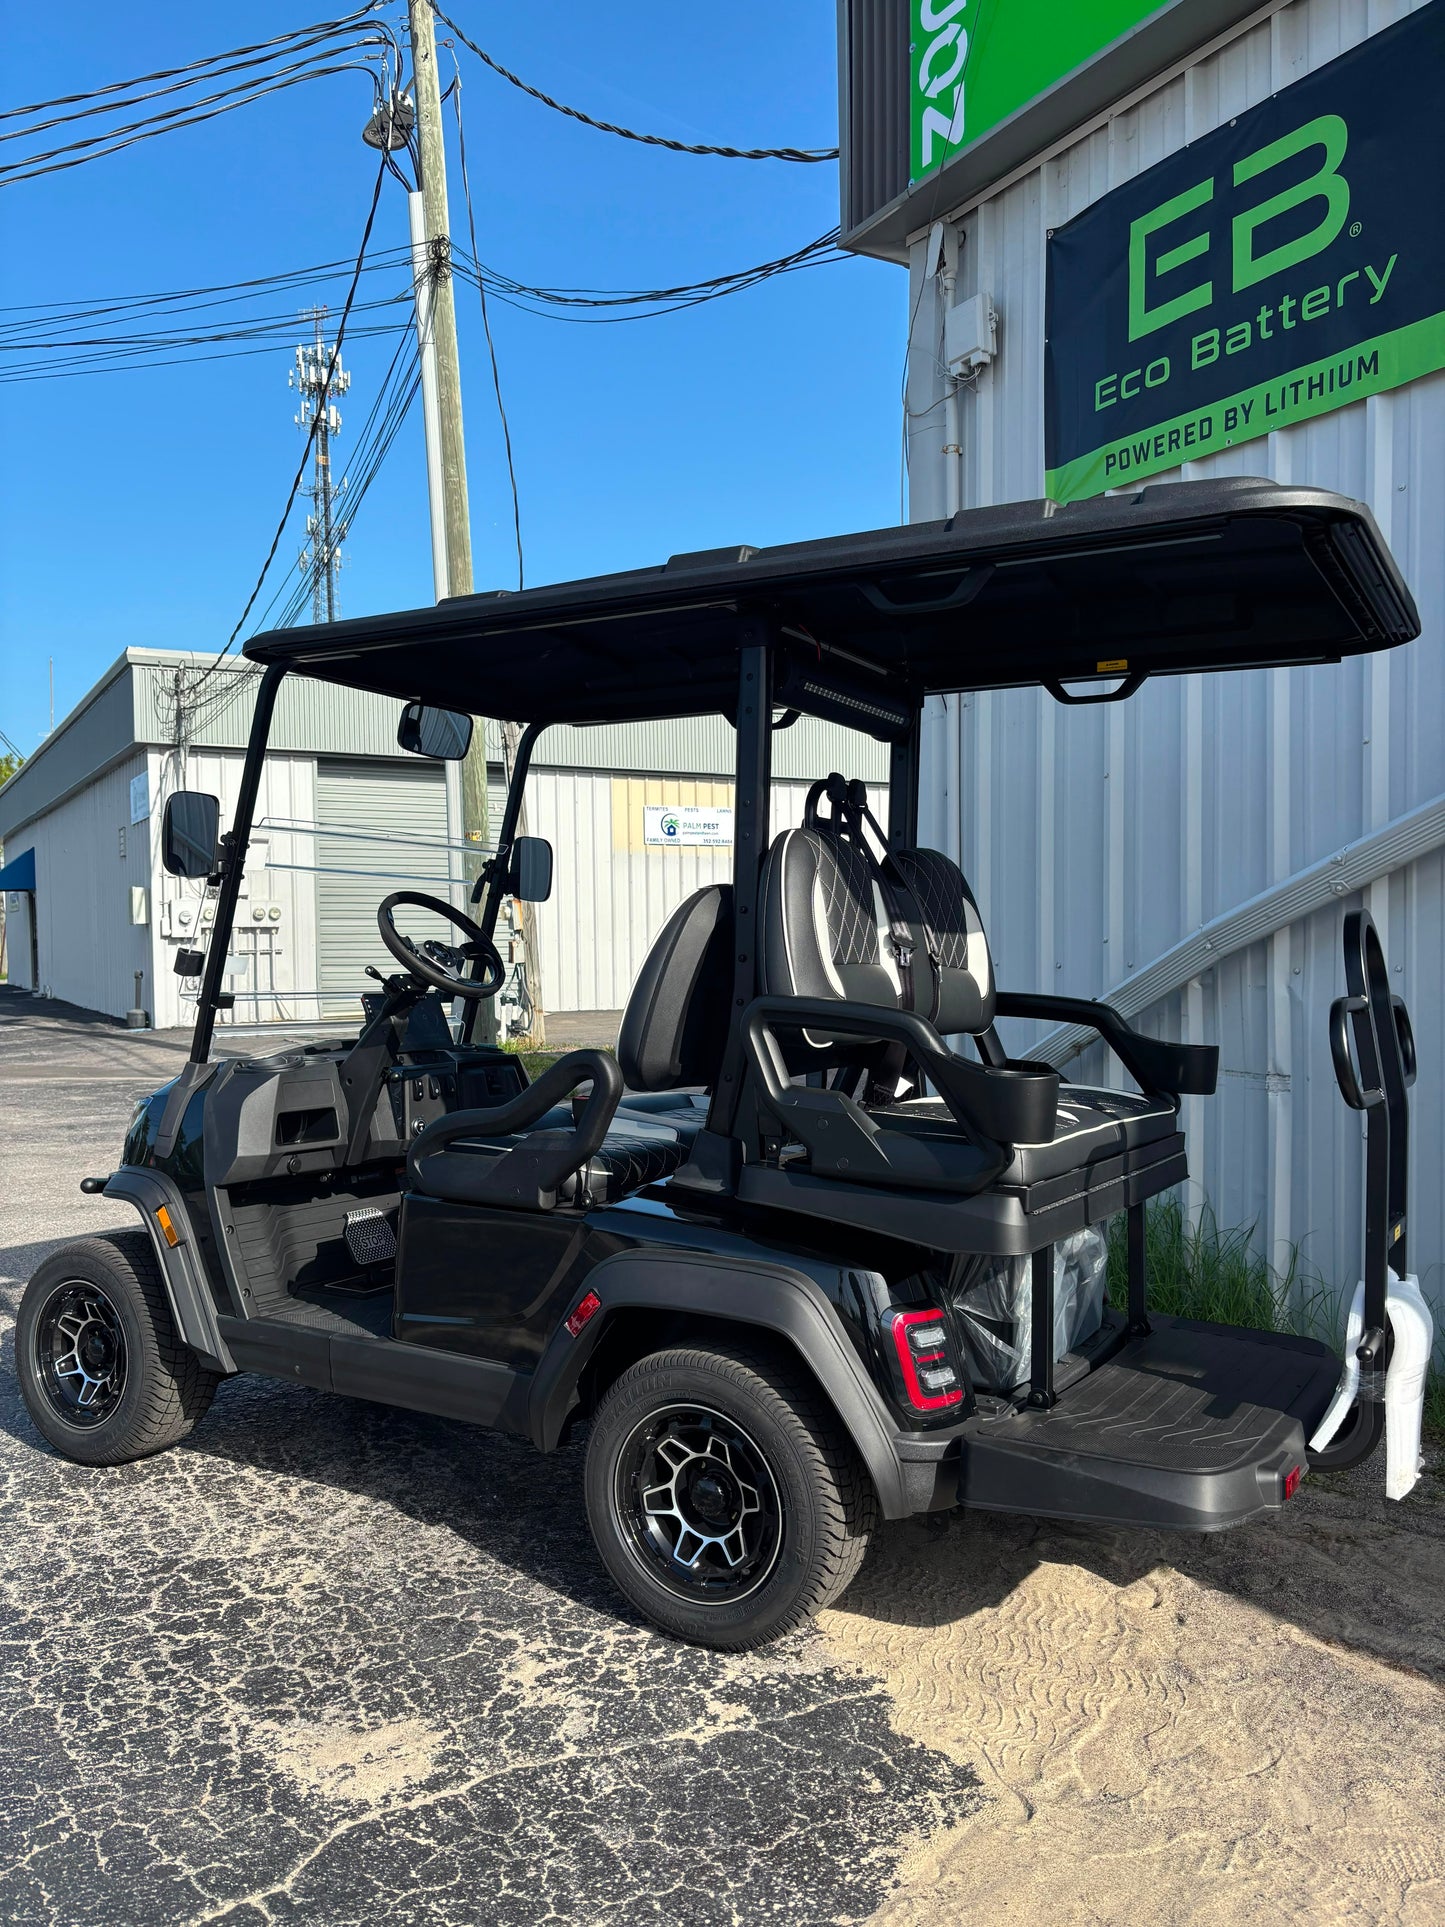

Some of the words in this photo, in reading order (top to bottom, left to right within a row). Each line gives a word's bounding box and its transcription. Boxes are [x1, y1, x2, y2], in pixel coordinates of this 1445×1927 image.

[1095, 356, 1170, 412] Eco
[1191, 253, 1398, 371] Battery
[1105, 416, 1213, 476] POWERED
[1224, 399, 1254, 432] BY
[1265, 349, 1379, 416] LITHIUM
[361, 1235, 383, 1248] STOP
